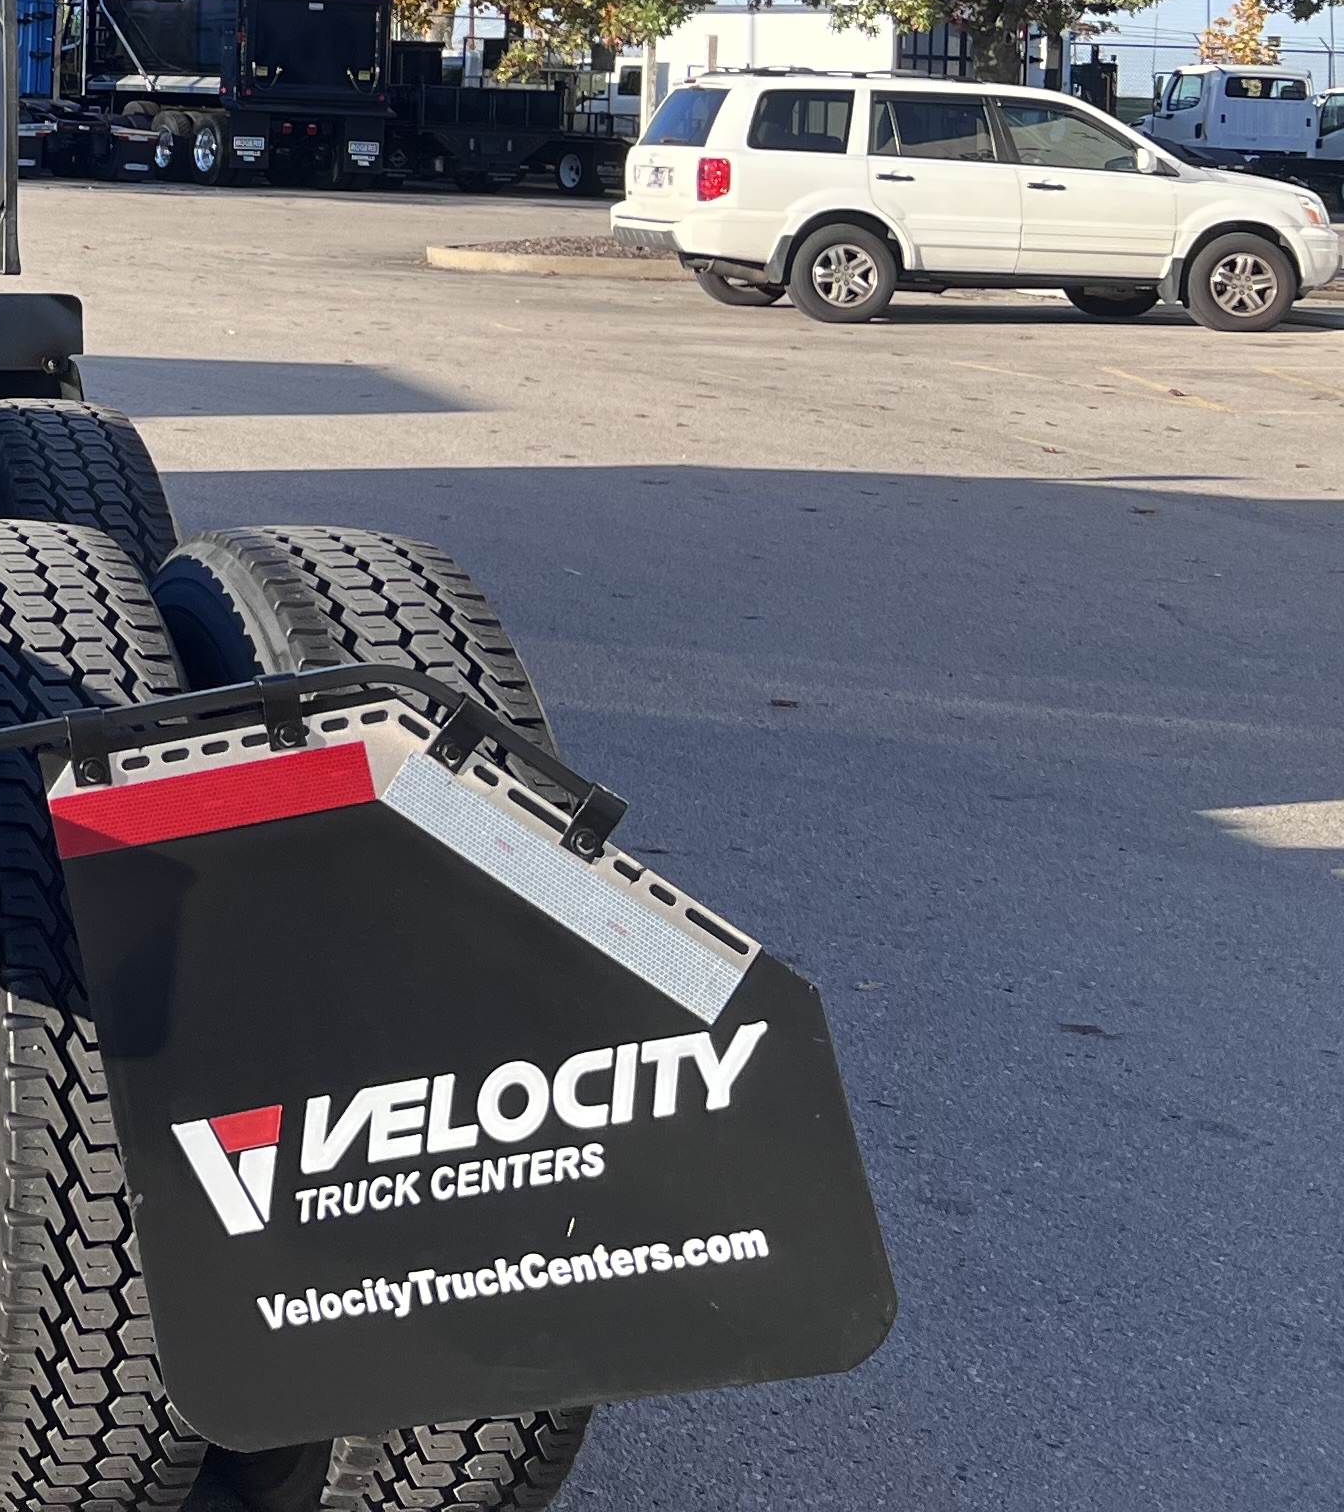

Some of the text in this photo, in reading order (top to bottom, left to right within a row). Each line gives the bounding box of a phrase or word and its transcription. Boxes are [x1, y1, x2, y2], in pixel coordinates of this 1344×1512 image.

[300, 1020, 768, 1175] VELOCITY
[295, 1142, 606, 1224] TRUCK CENTERS
[256, 1229, 770, 1330] VelocityTruckCenters.com
